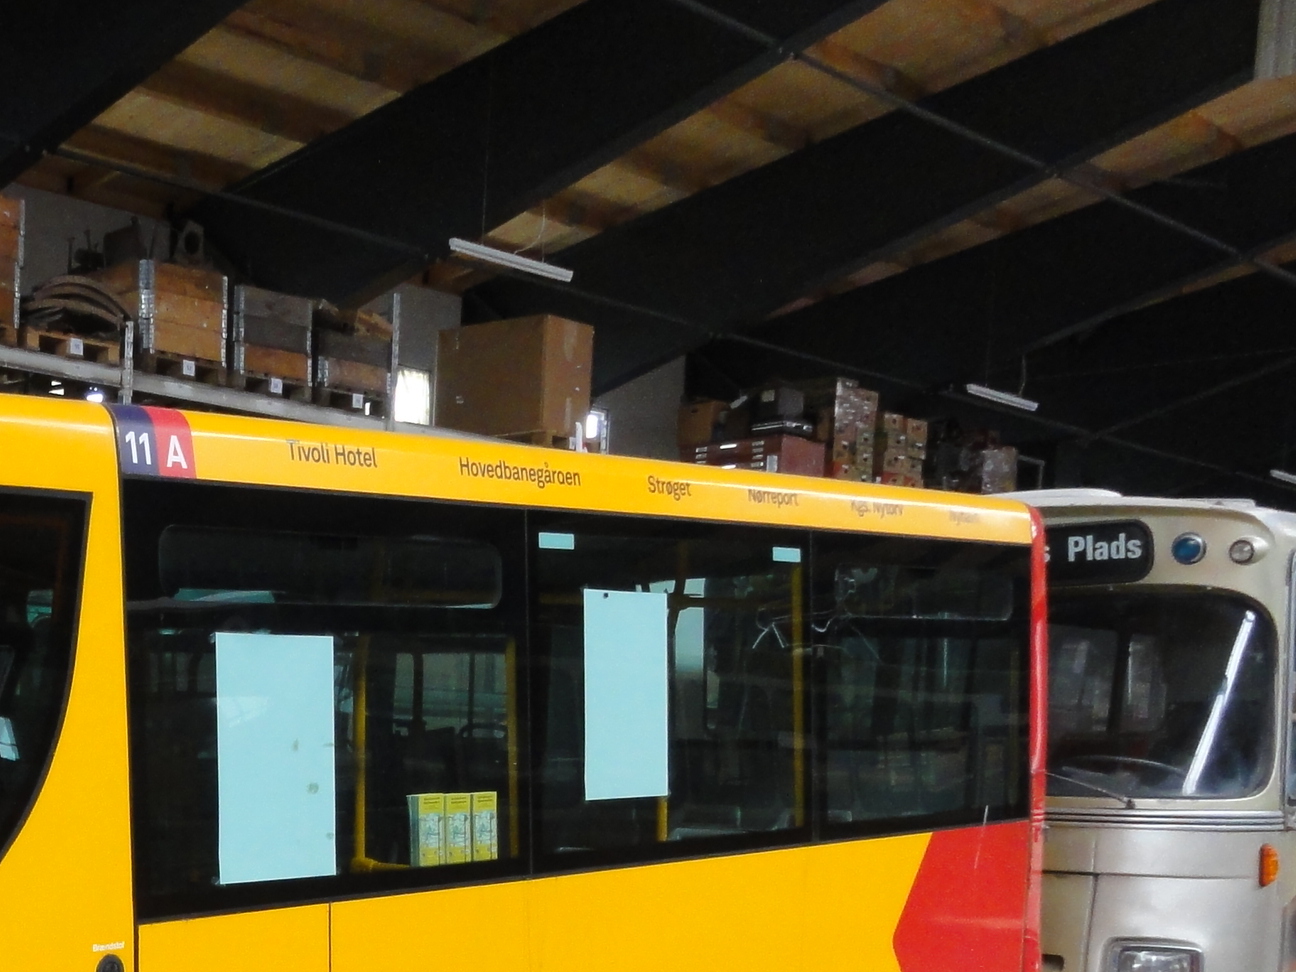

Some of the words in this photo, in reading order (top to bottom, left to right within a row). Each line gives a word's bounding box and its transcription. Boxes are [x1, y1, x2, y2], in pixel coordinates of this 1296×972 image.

[125, 430, 152, 466] 11
[166, 434, 188, 470] A
[285, 439, 331, 465] Tivoli
[334, 444, 378, 469] Hotel
[647, 474, 693, 502] Strøget
[748, 488, 800, 510] Nørreport
[1067, 532, 1143, 562] Plads
